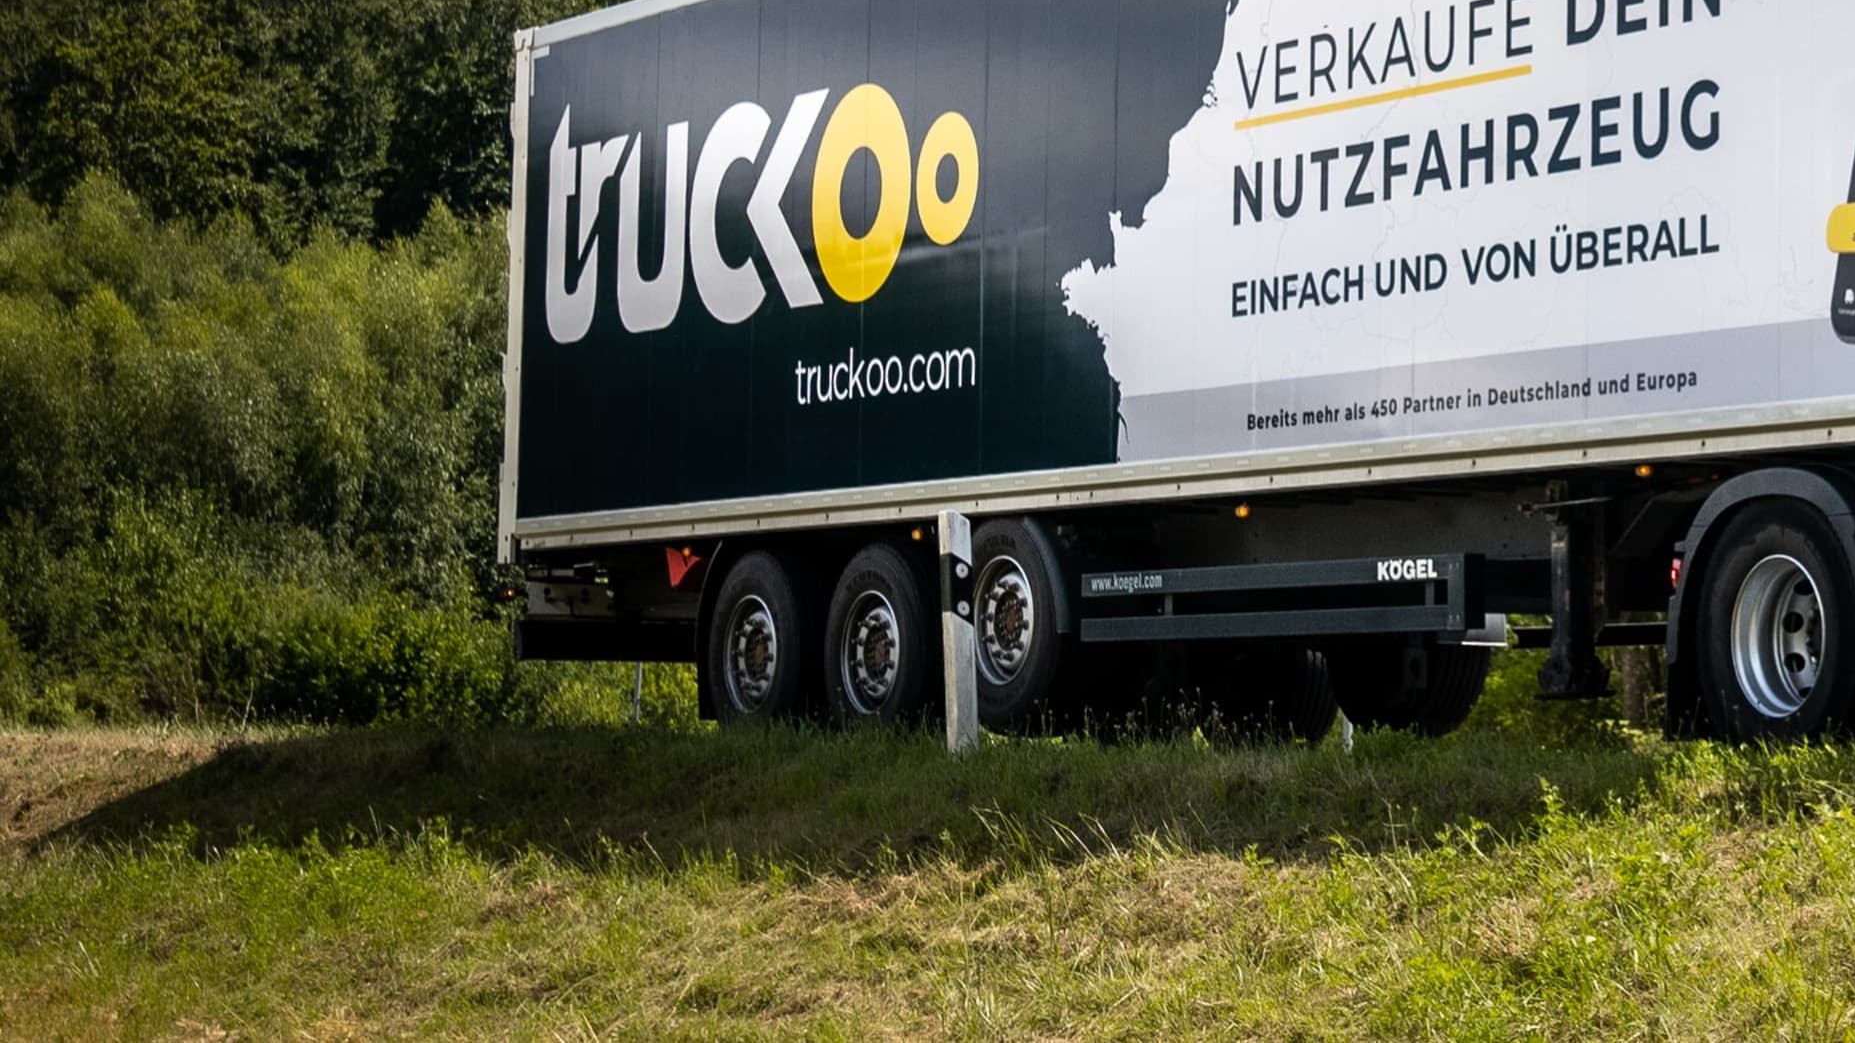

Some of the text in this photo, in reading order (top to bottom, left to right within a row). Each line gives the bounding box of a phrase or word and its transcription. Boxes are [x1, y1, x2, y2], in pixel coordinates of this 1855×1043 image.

[1233, 78, 1720, 226] NUTZFAHRZEUG
[1231, 214, 1720, 317] EINFACH UND VON ÜBERALL
[795, 347, 976, 405] truckoo.com
[1247, 371, 1698, 431] Bereits mehr als 450 Partner in Deutschland und Europa
[1090, 572, 1163, 594] www.koegel.com
[1377, 558, 1438, 581] KÖGEL
